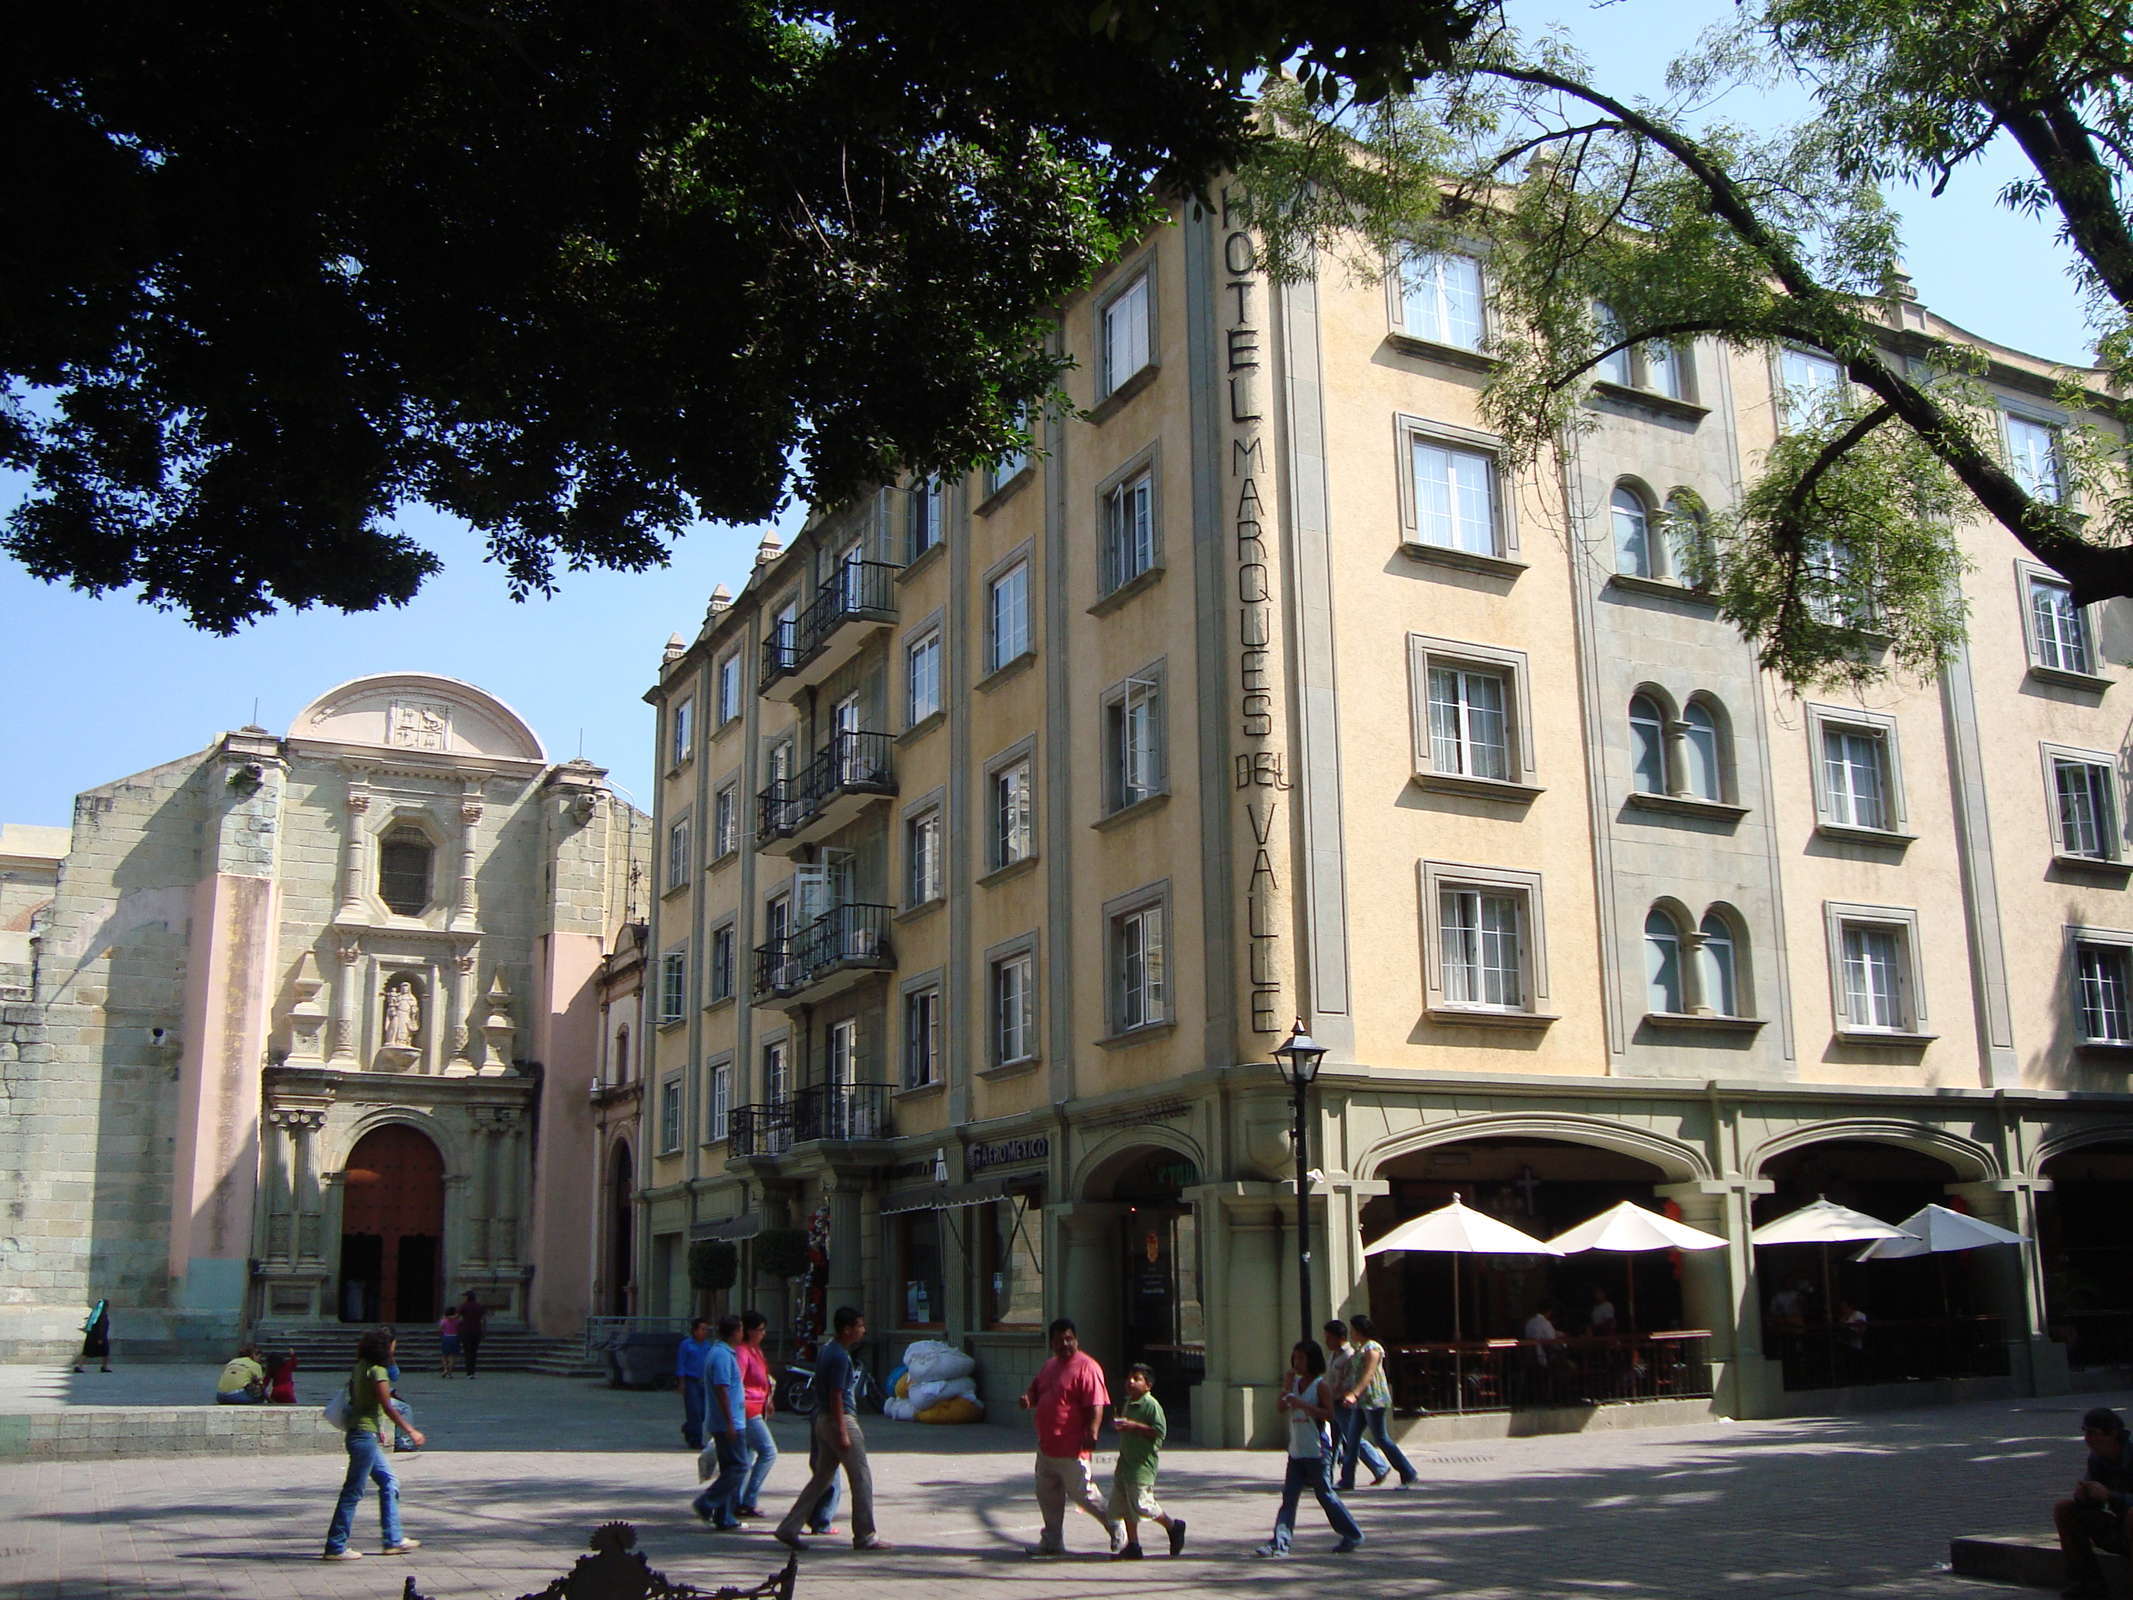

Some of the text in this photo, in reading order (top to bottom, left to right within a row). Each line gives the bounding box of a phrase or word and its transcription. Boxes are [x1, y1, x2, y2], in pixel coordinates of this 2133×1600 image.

[1233, 437, 1273, 737] MARQUES
[1235, 752, 1294, 792] DEL
[1246, 803, 1281, 1033] VALLE
